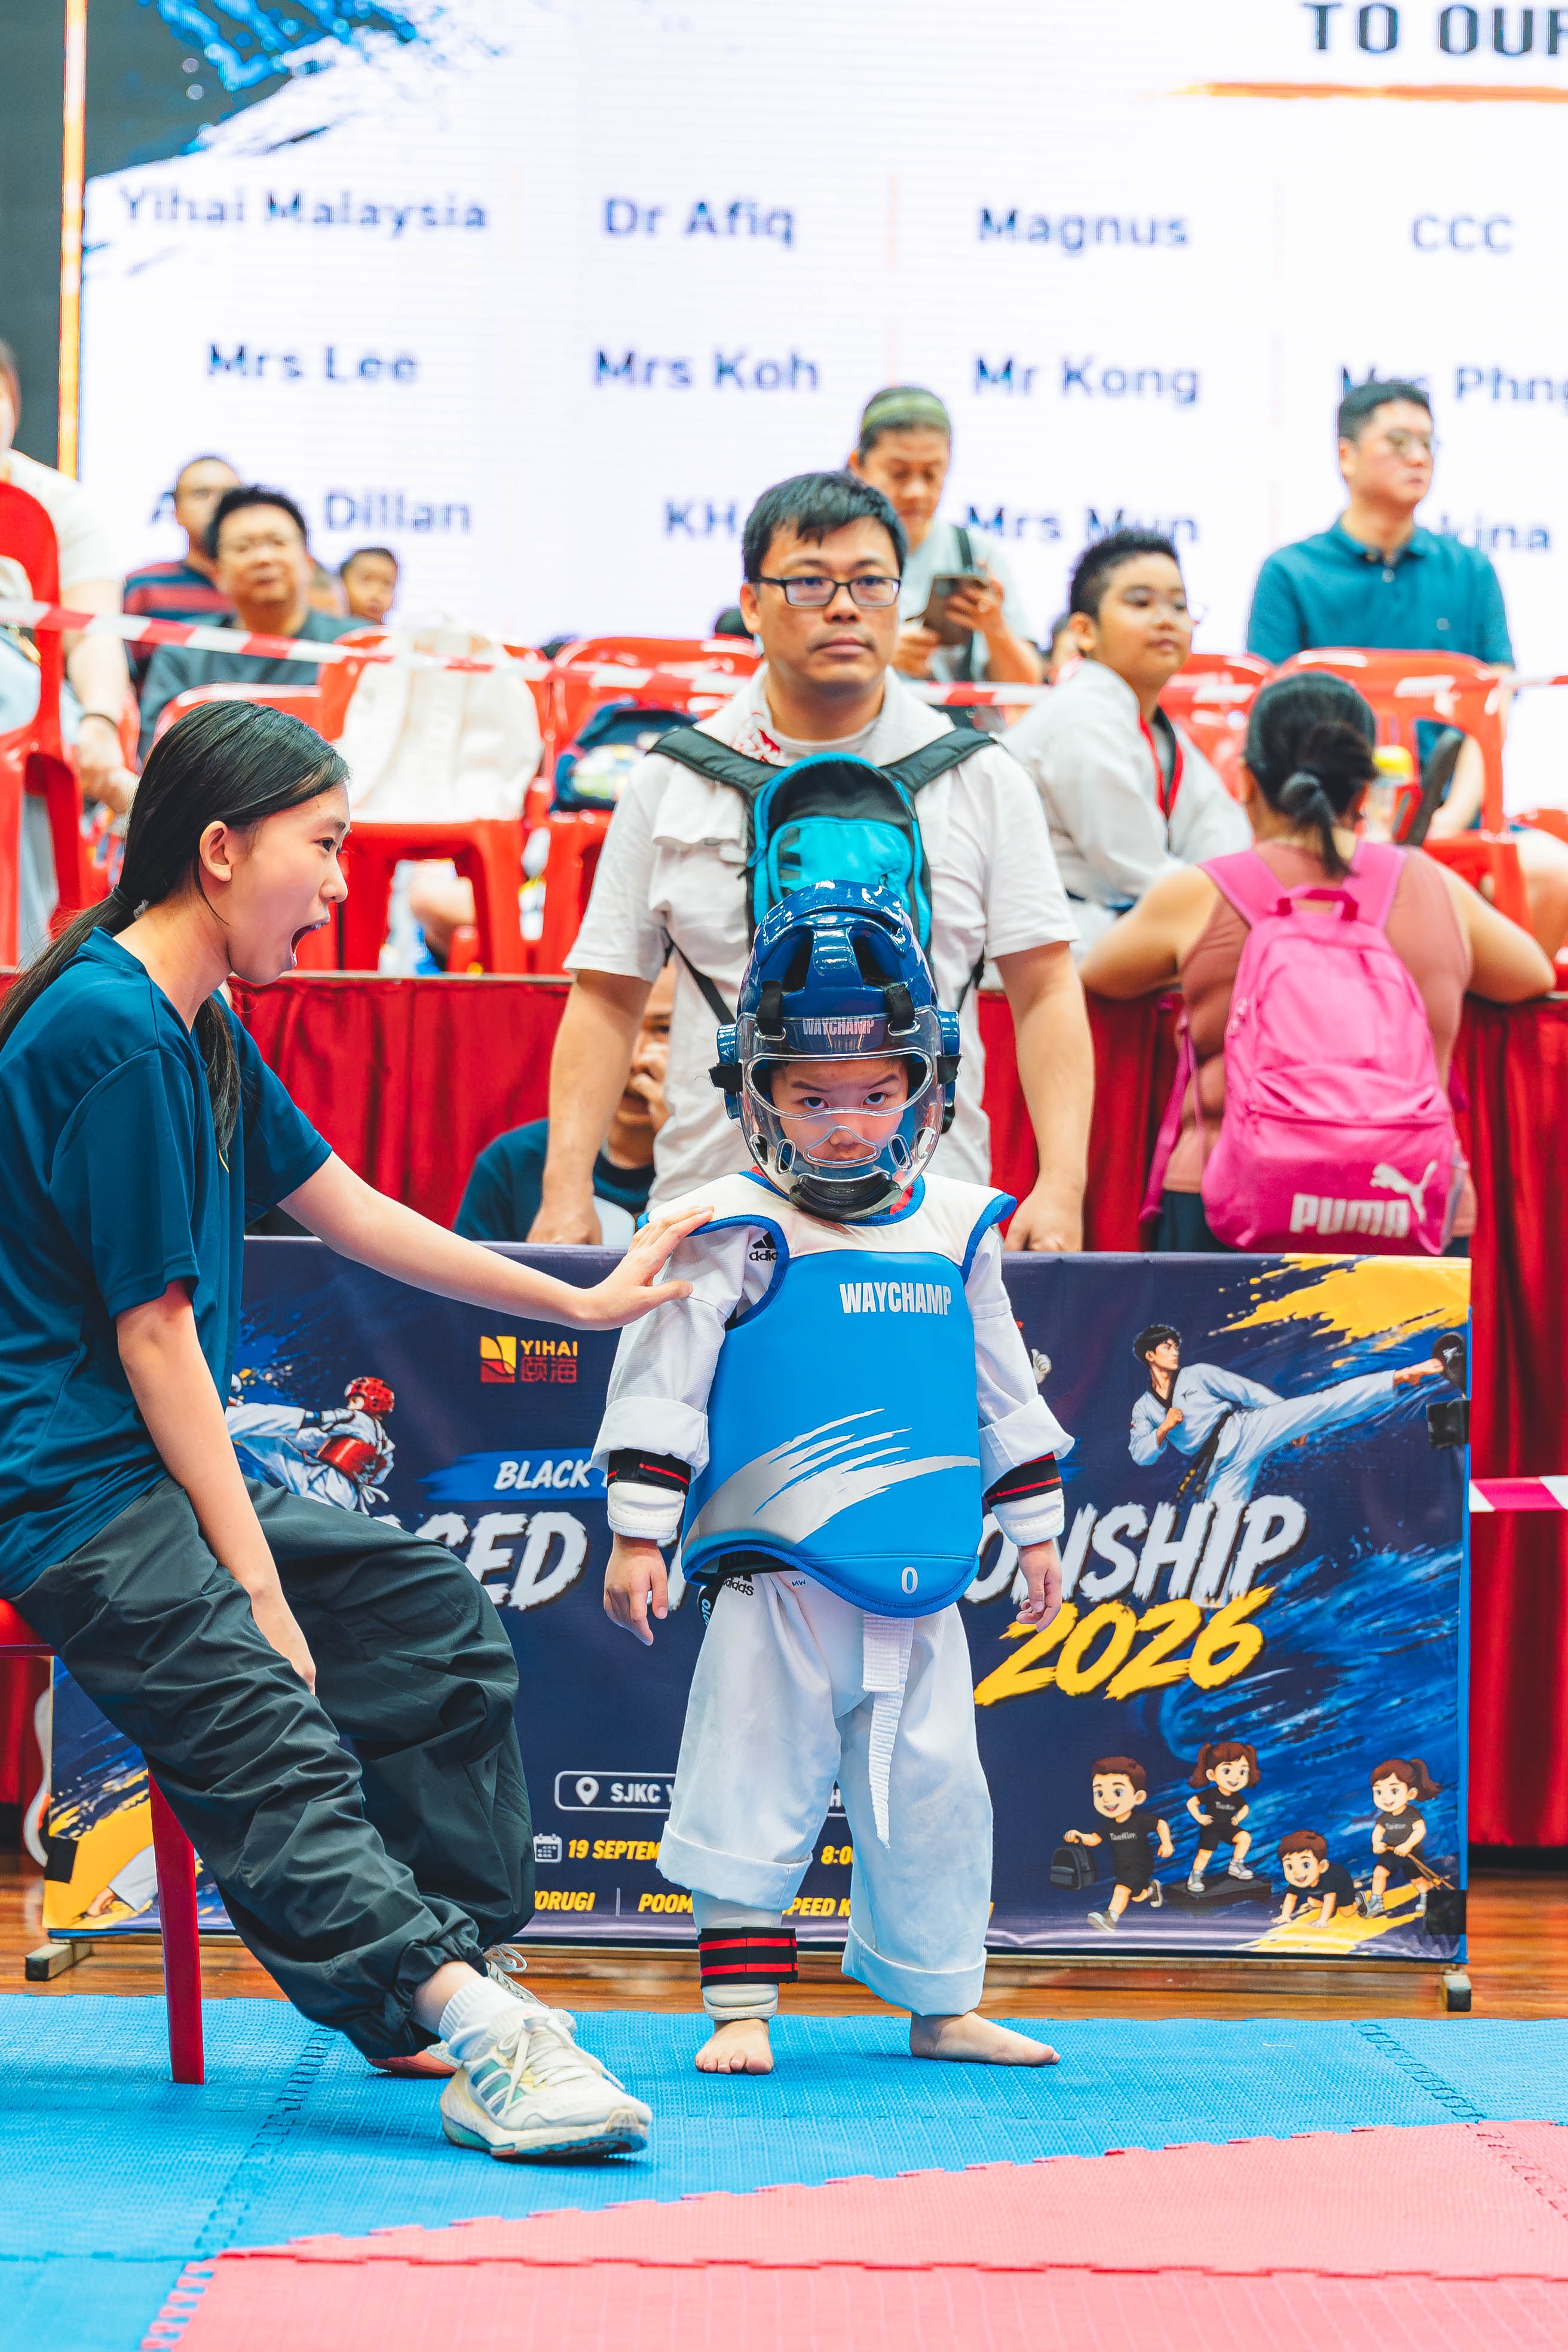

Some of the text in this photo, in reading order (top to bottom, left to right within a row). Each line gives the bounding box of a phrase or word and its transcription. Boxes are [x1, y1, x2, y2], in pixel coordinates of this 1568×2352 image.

[1304, 4, 1399, 53] TO
[120, 186, 487, 240] Yihai Malaysia
[604, 197, 796, 250] Dr Afiq
[980, 207, 1190, 257] Magnus
[1411, 215, 1512, 253] CCC
[209, 342, 419, 382] Mrs Lee
[593, 349, 820, 391] Mrs Koh
[975, 354, 1201, 408] Mr Kong
[1454, 365, 1568, 414] Phn
[324, 488, 472, 532] Dillan
[966, 505, 1061, 540] Mrs
[803, 1017, 875, 1035] WAYCHAMP
[1288, 1193, 1410, 1238] PUMA
[839, 1282, 952, 1316] WAYCHAMP
[520, 1340, 578, 1356] YIHAI
[494, 1459, 593, 1491] BLACK
[724, 1576, 755, 1596] didas
[973, 1584, 1276, 1708] 2026
[610, 1783, 662, 1803] SJKC
[568, 1839, 662, 1861] 19 SEPTEM
[820, 1845, 853, 1865] 8:0
[534, 1890, 596, 1912] ORUGI
[637, 1892, 693, 1913] POOM
[782, 1897, 837, 1917] PEED
